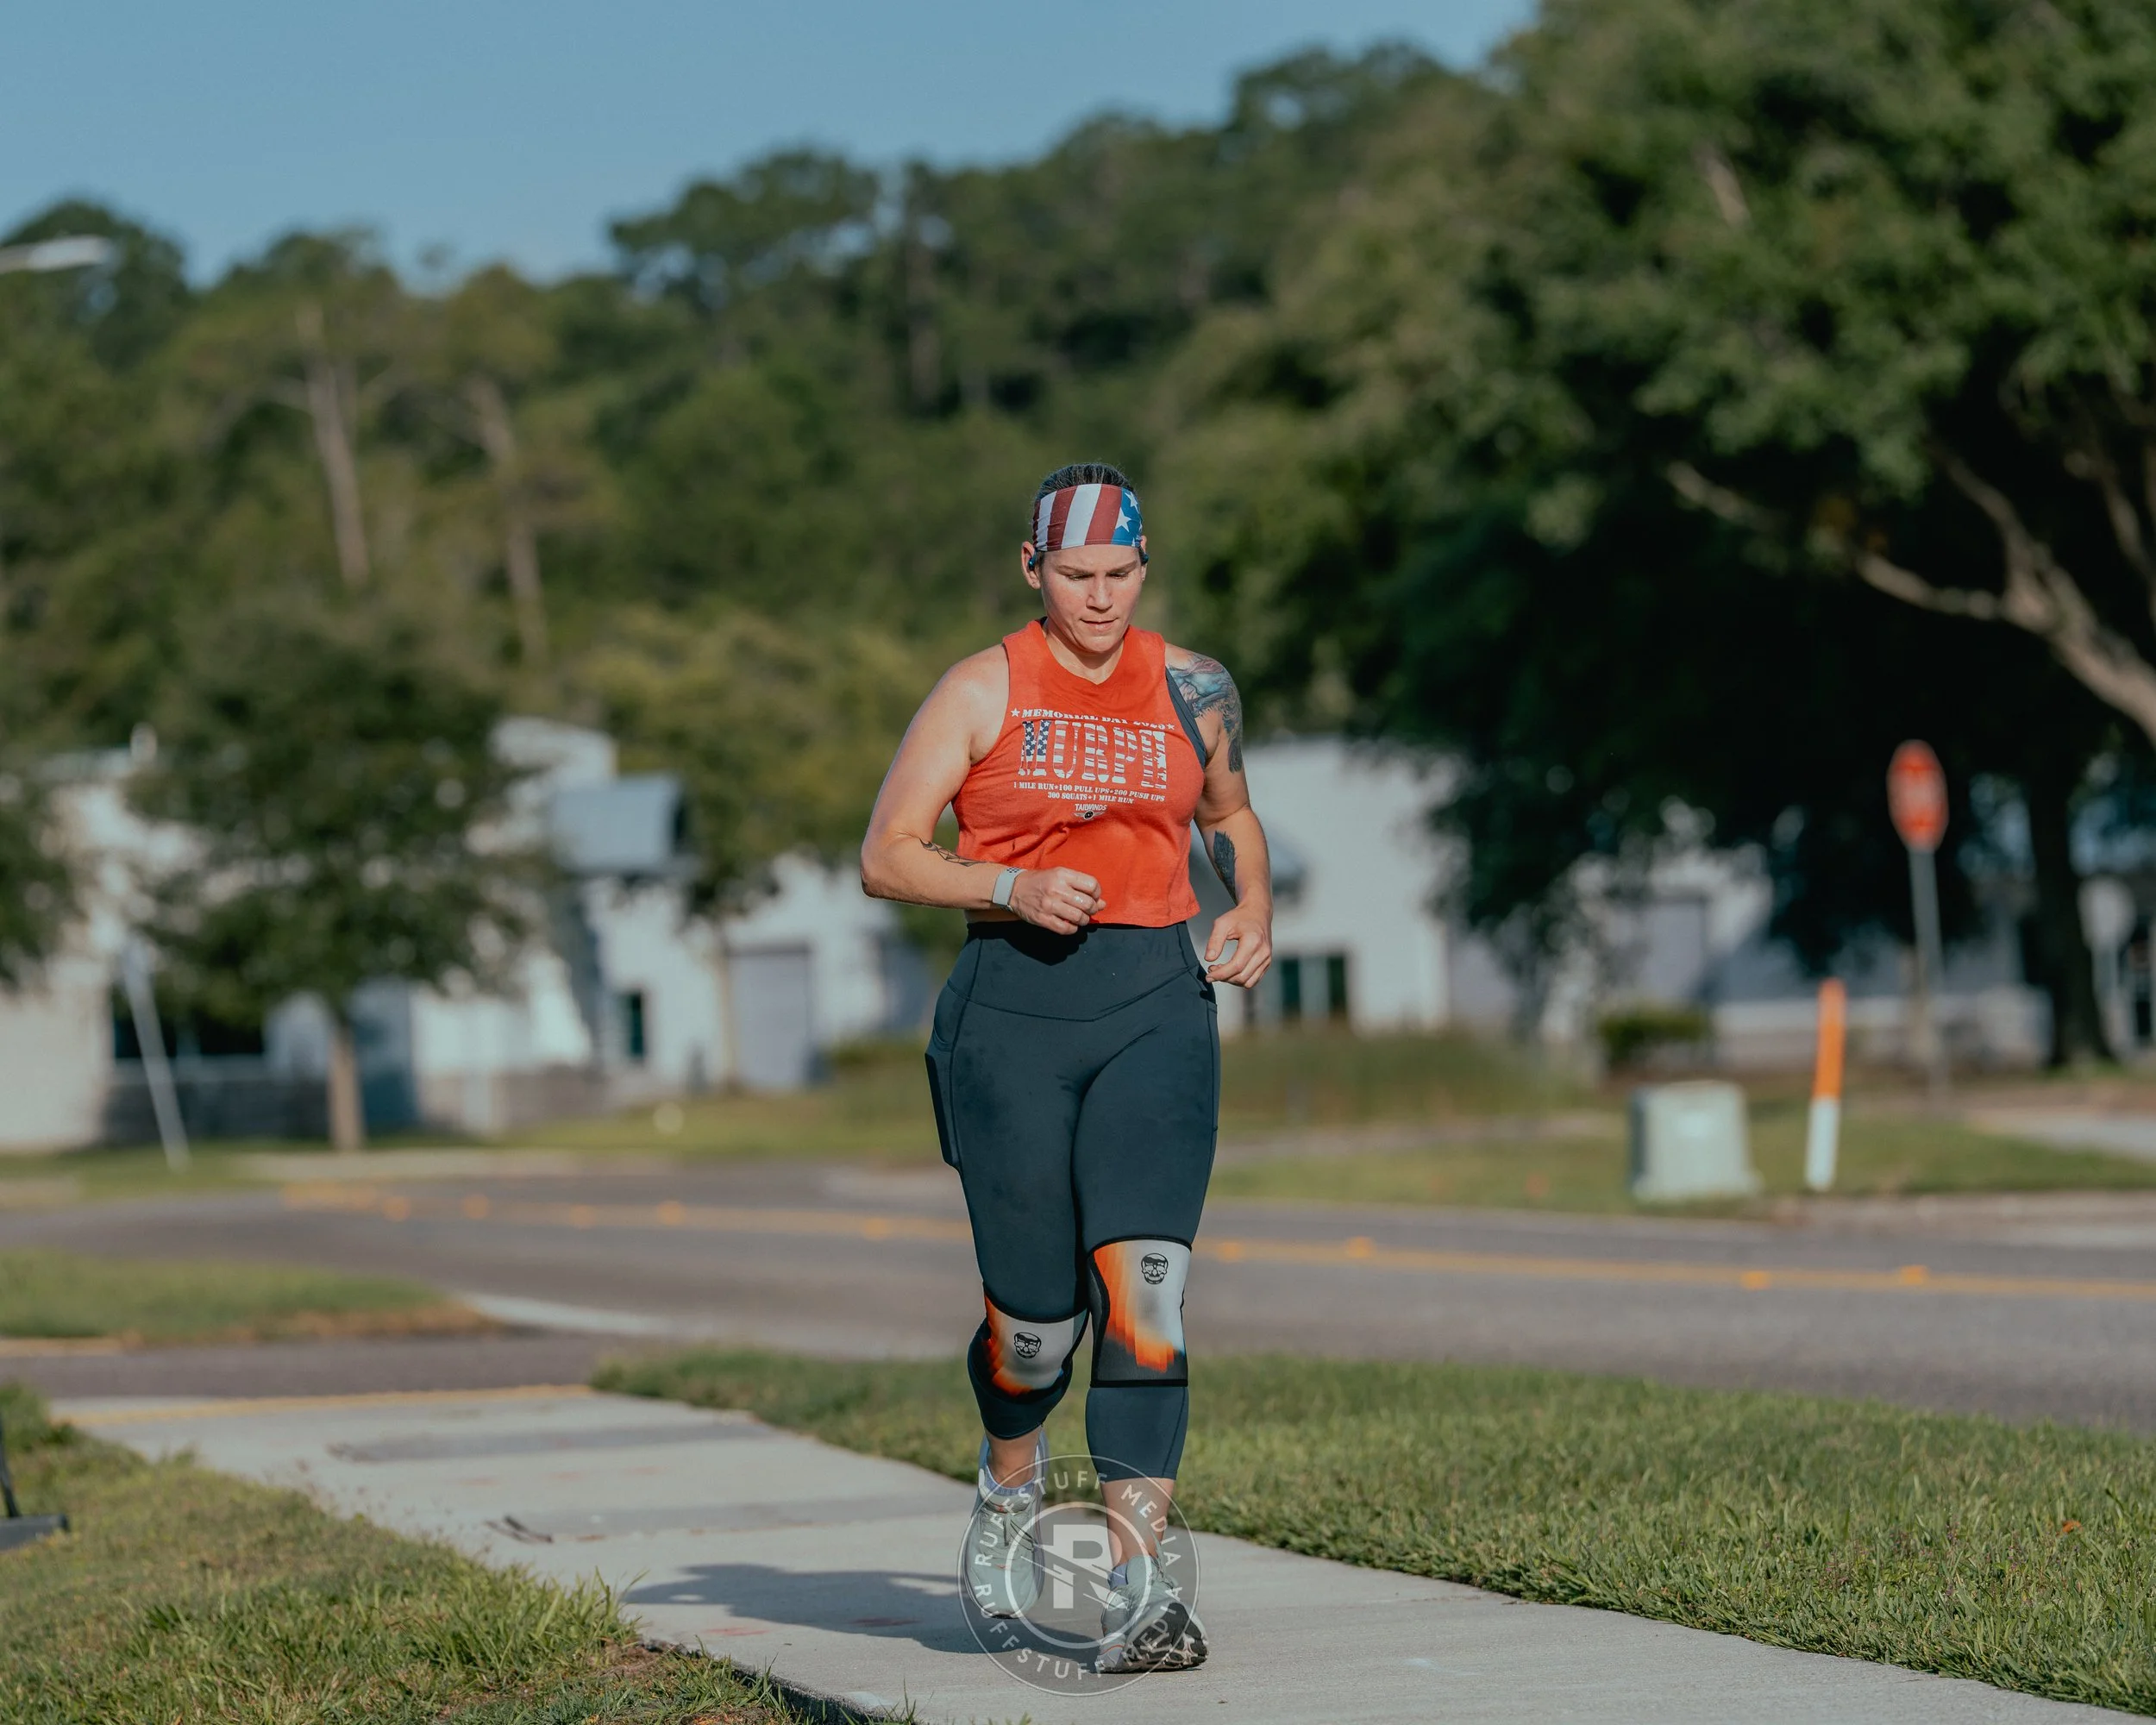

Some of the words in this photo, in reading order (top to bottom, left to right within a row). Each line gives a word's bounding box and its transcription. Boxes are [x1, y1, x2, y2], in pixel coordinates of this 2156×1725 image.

[1021, 709, 1099, 721] MEMORIAL
[1018, 718, 1167, 790] MURPH
[1061, 792, 1087, 800] SQUATS
[1129, 790, 1150, 800] PUSH
[1150, 794, 1165, 802] UPS
